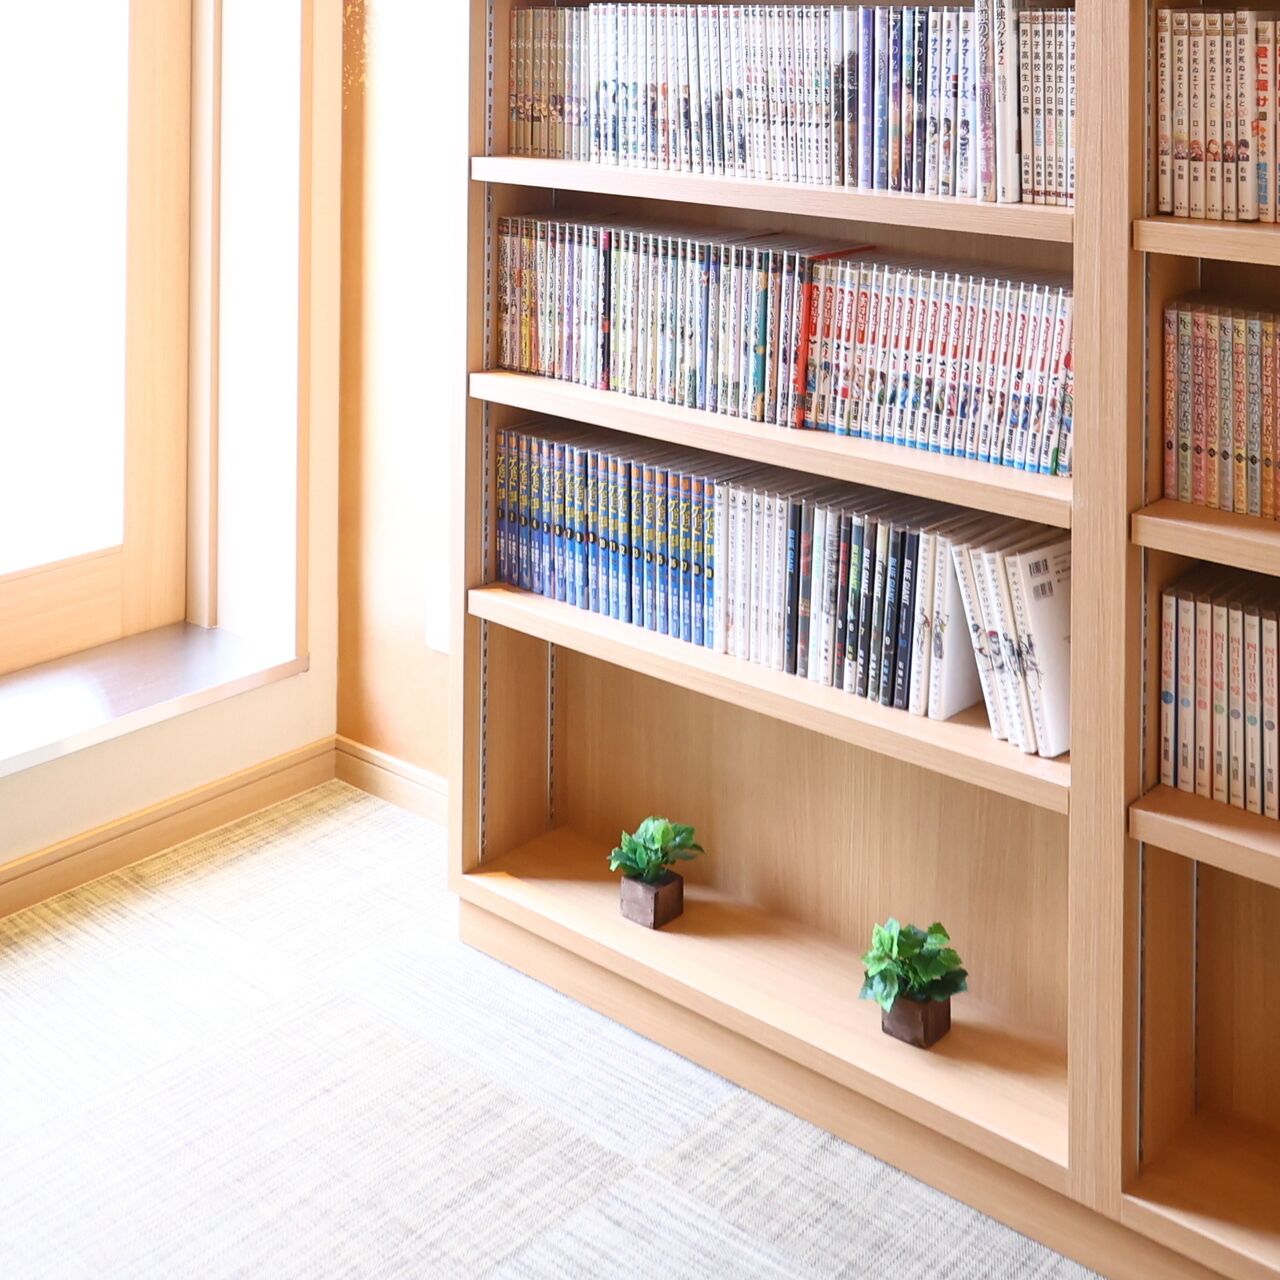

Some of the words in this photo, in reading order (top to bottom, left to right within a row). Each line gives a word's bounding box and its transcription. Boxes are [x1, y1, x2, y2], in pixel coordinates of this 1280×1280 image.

[944, 38, 952, 98] サマーウォーズ
[1021, 29, 1029, 114] 男子高校生の日常
[1033, 30, 1041, 116] 男子高校生の日常
[888, 557, 896, 579] BLUE
[904, 559, 912, 581] BLUE
[902, 582, 910, 605] GIANT
